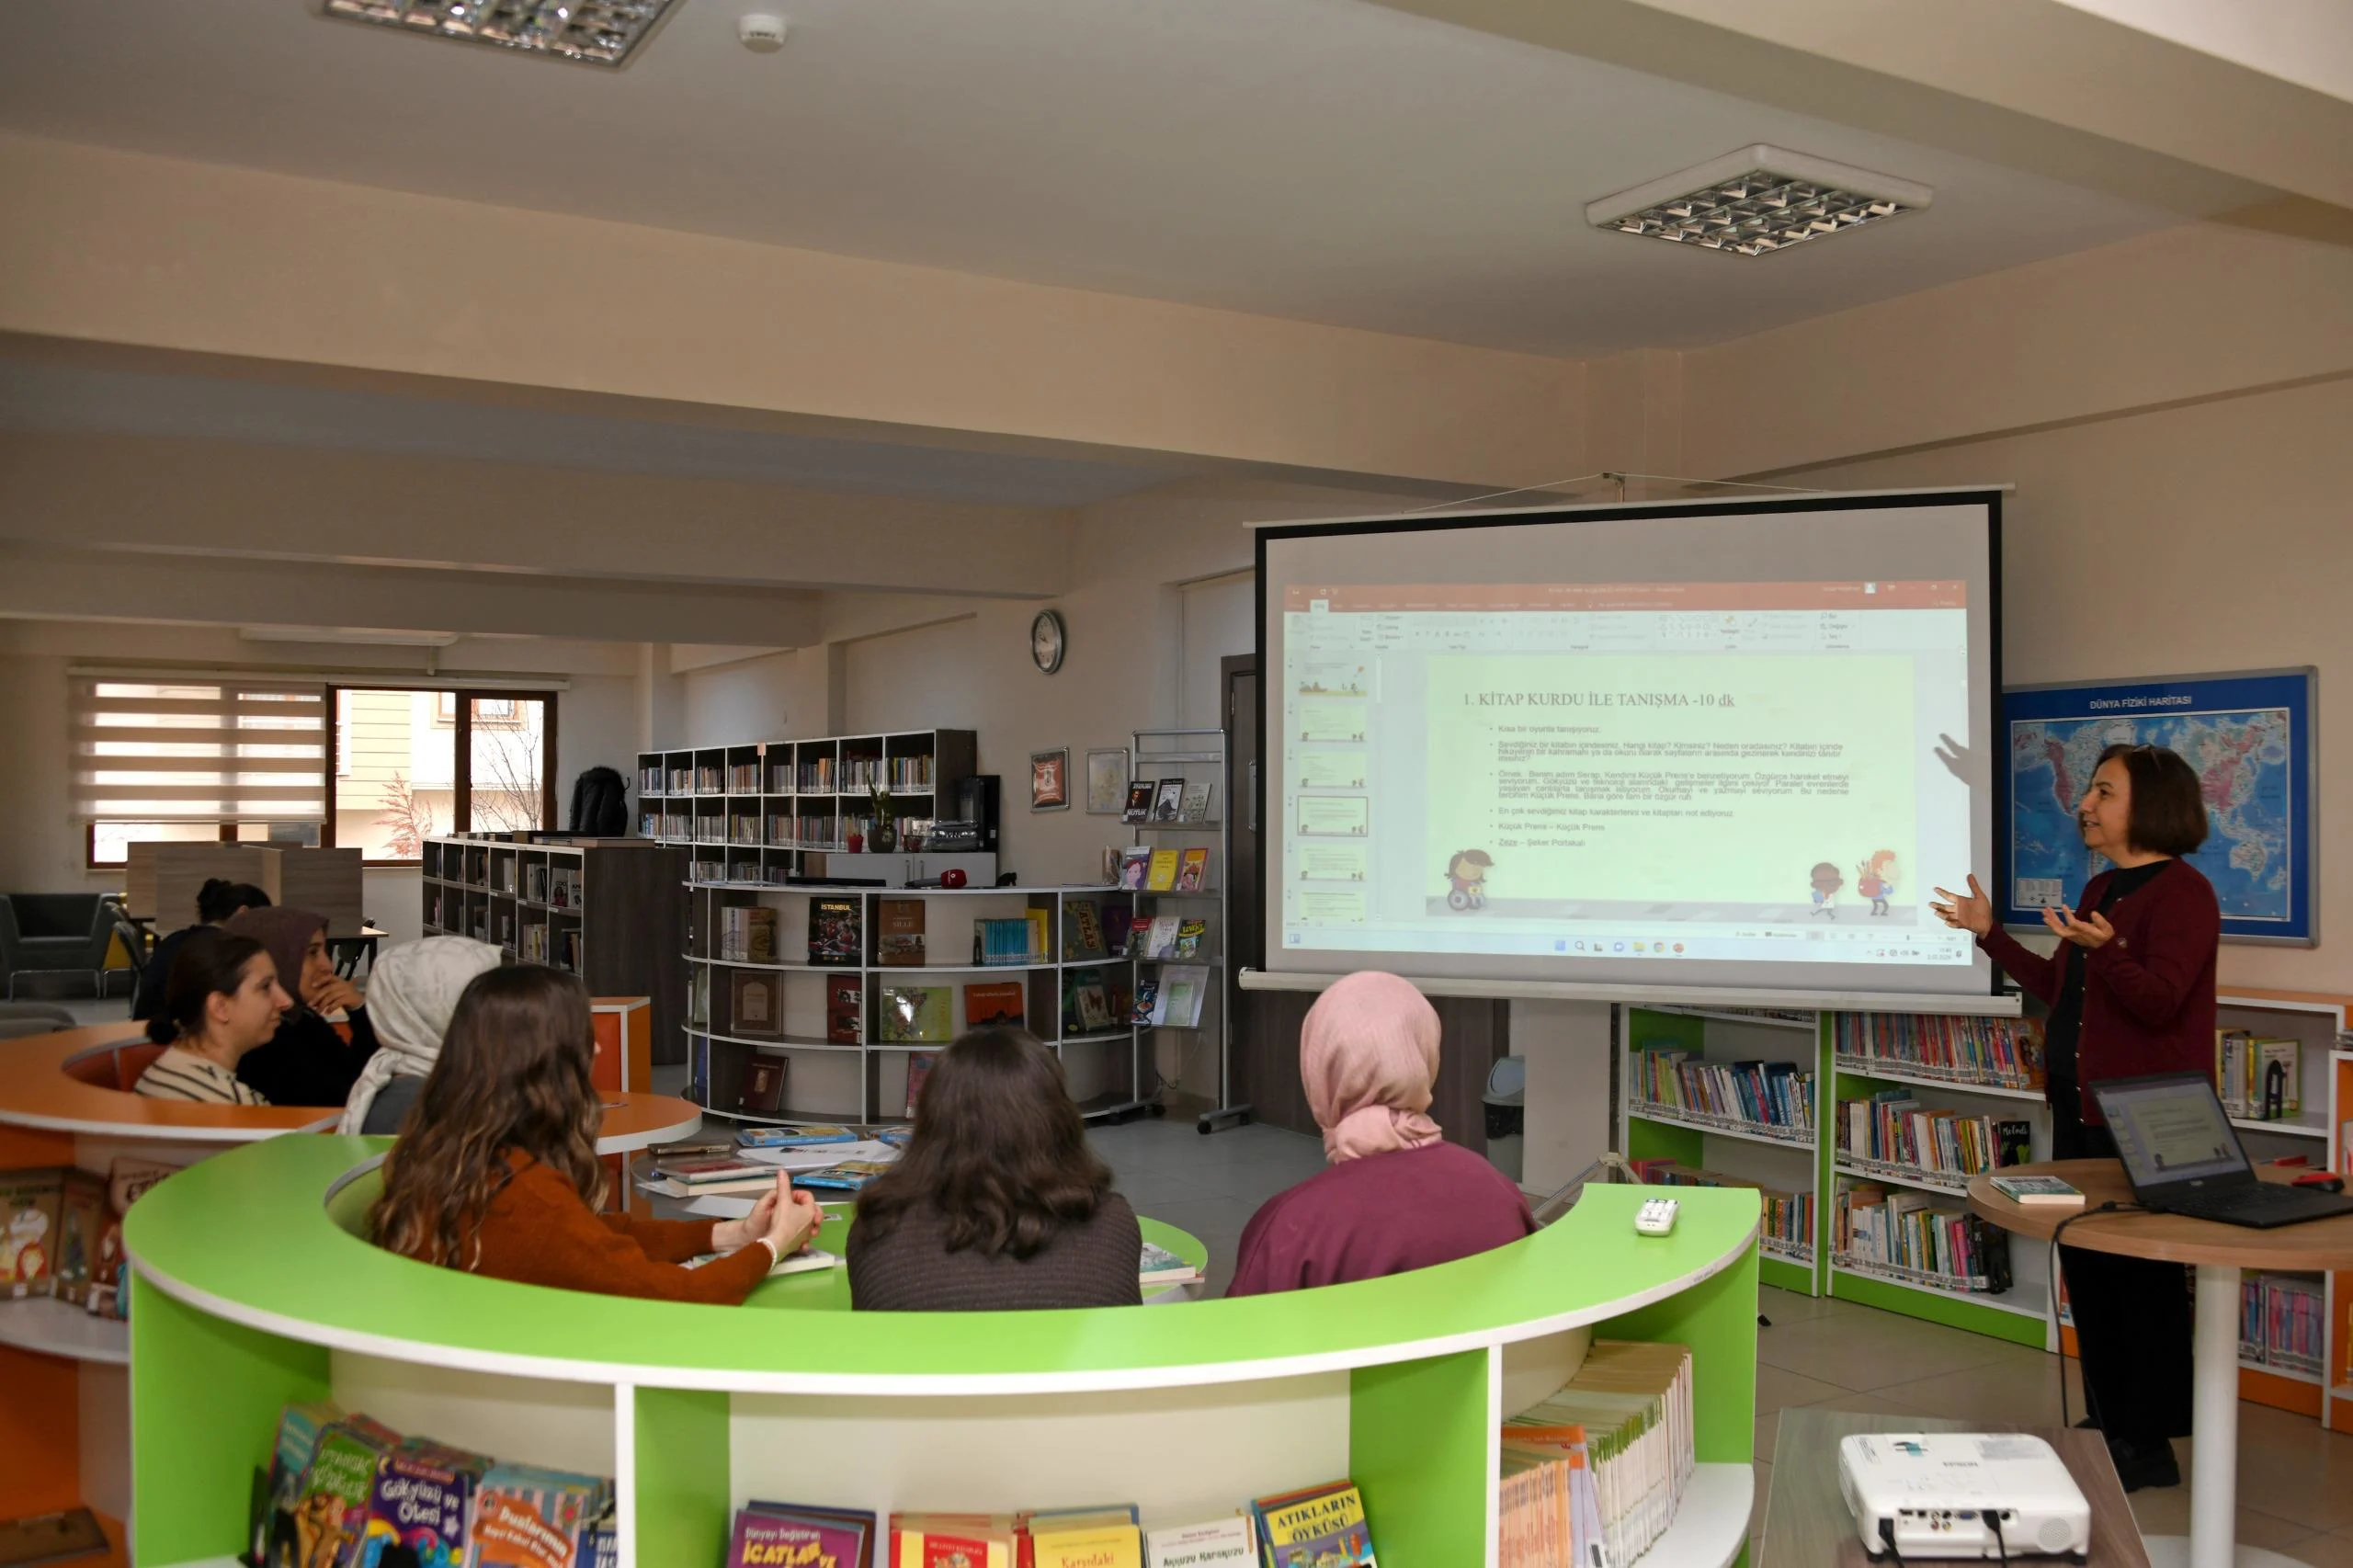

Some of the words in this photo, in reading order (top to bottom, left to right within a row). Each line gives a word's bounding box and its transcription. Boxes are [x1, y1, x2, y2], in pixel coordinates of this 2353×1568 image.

[1463, 693, 1474, 706] 1.
[1479, 690, 1523, 707] KİTAP
[1528, 693, 1584, 707] KURDU
[1589, 690, 1613, 706] İLE
[1617, 693, 1688, 709] TANIŞMA
[1692, 694, 1714, 707] -10
[1718, 693, 1735, 707] dk
[2090, 699, 2120, 710] DÜNYA
[2121, 696, 2147, 708] FİZİKİ
[2149, 695, 2192, 707] HARİTASI
[821, 902, 853, 911] İSTANBUL
[381, 1478, 442, 1505] Gökyüzü
[442, 1494, 460, 1512] ve
[398, 1498, 441, 1527] Ötesi
[1278, 1494, 1356, 1530] ATIKLARIN
[1292, 1513, 1348, 1543] ÖYKÜSÜ
[743, 1540, 821, 1565] İCATLAR
